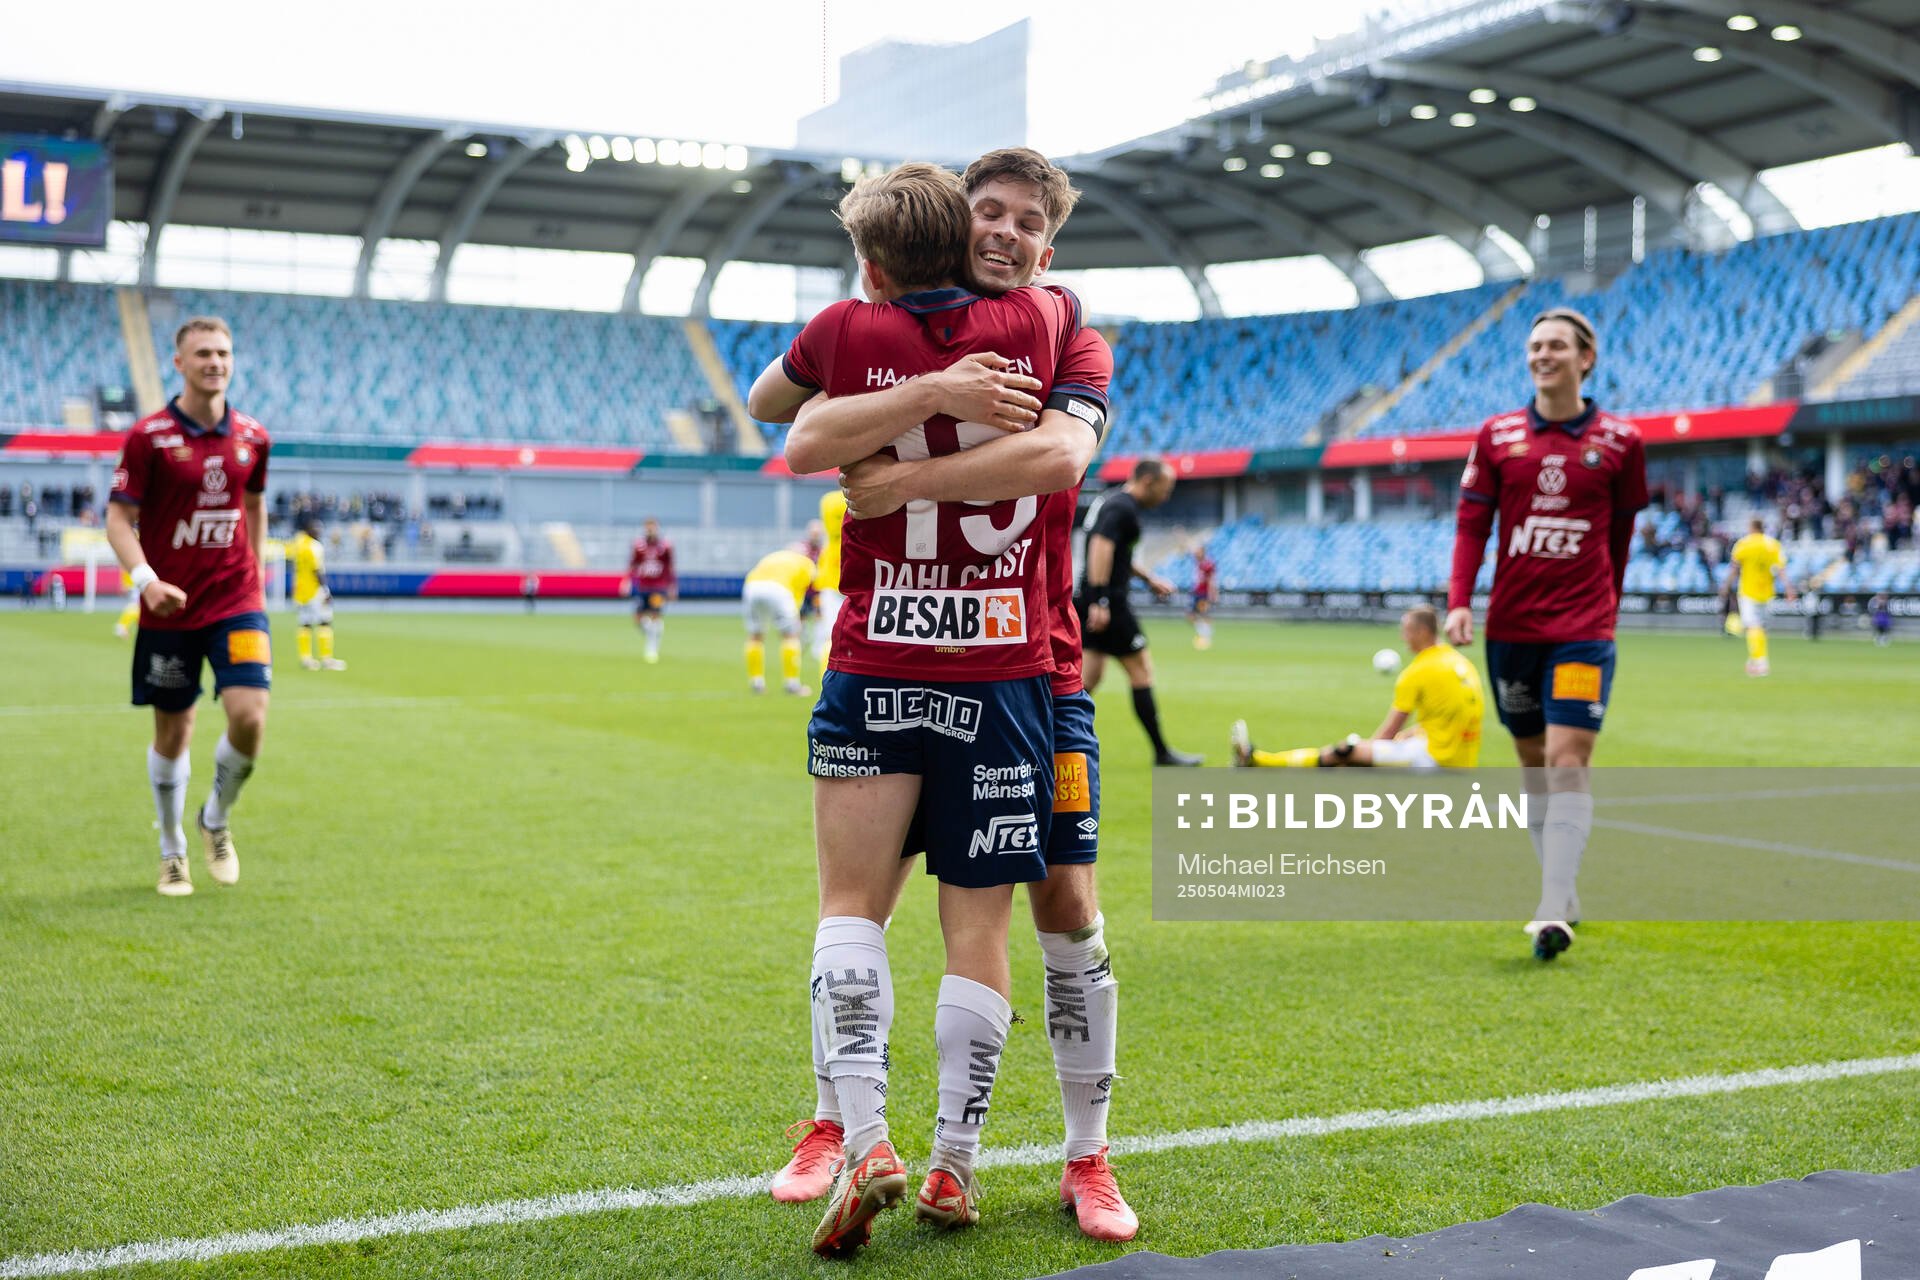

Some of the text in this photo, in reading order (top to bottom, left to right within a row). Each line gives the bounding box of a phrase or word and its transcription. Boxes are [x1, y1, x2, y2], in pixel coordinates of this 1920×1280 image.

[2, 158, 68, 224] L!
[873, 595, 981, 640] BESAB
[934, 645, 966, 654] umbro
[944, 728, 976, 744] GROUP
[812, 756, 881, 778] Månsson
[968, 813, 1038, 858] NTEX
[824, 968, 880, 1056] MIKE
[1046, 965, 1090, 1042] MIKE
[961, 1039, 1001, 1125] MIKE
